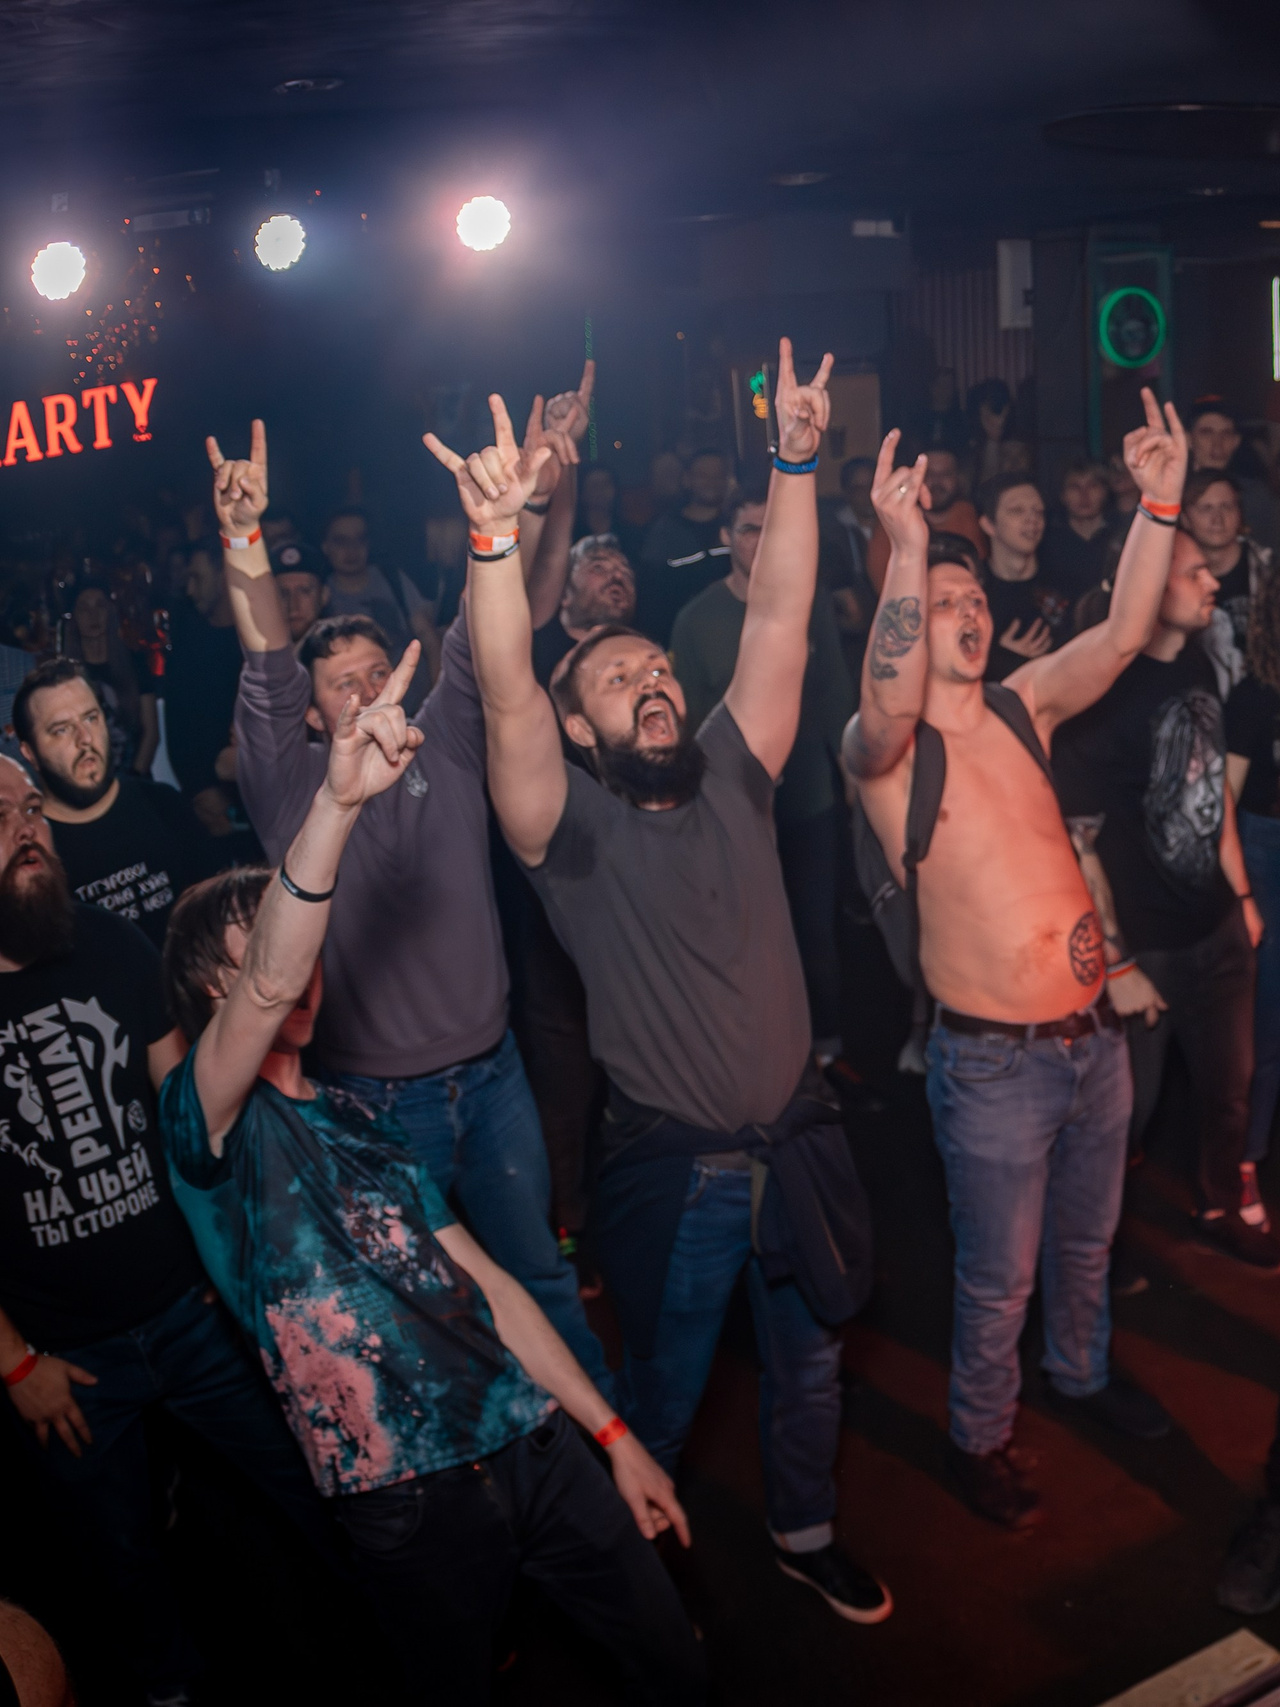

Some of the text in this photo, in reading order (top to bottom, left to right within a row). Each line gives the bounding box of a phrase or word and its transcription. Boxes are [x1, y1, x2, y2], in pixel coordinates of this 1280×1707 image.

[0, 378, 158, 466] ARTY
[17, 1003, 112, 1168] РЕШАЙ
[23, 1141, 153, 1224] НА ЧЬЕЙ
[30, 1180, 160, 1248] ТЫ СТОРОНЕ
